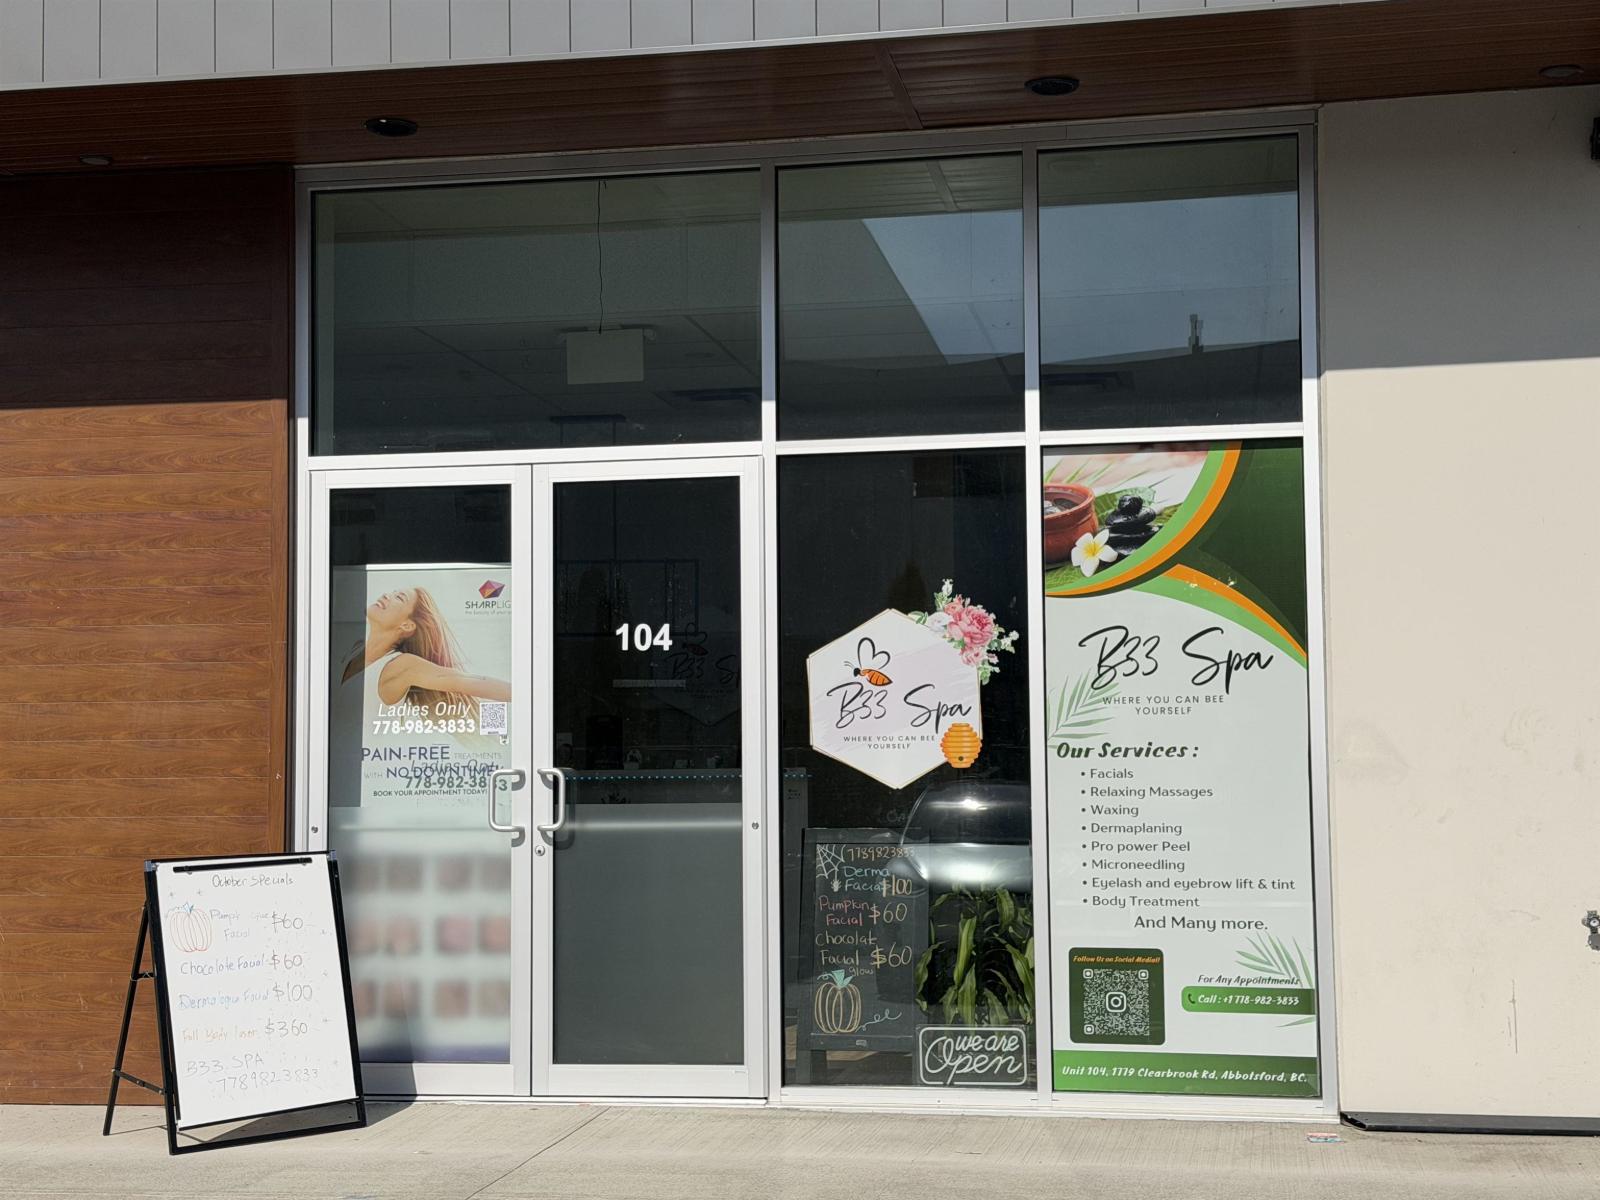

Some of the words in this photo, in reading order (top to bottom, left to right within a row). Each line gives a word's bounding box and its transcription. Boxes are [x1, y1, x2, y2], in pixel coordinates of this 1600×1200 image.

[615, 623, 673, 651] 104
[1078, 625, 1160, 691] B33
[1181, 626, 1274, 694] Spa
[826, 681, 888, 729] B33
[903, 683, 972, 734] Spa
[1102, 696, 1141, 705] WHERE
[1146, 696, 1170, 704] YOU
[1175, 695, 1200, 704] CAN
[1204, 695, 1224, 703] BEE
[378, 702, 429, 717] Ladies
[435, 701, 471, 718] Only
[1135, 706, 1192, 715] YOURSELF
[372, 719, 476, 735] 778-982-3833
[361, 746, 451, 762] PAIN-FREE
[1056, 742, 1094, 758] Our
[386, 767, 409, 779] NO
[1090, 768, 1134, 779] Facials
[405, 776, 508, 792] 778-982-383
[414, 789, 461, 797] APPOINTMENT
[1090, 786, 1146, 799] Relaxing
[1149, 786, 1214, 799] Massages
[1091, 805, 1139, 817] Waxing
[1091, 822, 1183, 836] Dermaplaning
[1091, 841, 1114, 852] Pro
[1117, 843, 1159, 854] power
[1162, 841, 1191, 852] Peel
[842, 866, 890, 878] Derma
[1092, 859, 1185, 872] Microneedling
[212, 874, 248, 888] October
[1092, 877, 1142, 891] Eyelash
[1145, 877, 1170, 889] and
[1174, 878, 1233, 891] eyebrow
[1236, 878, 1254, 890] lift
[1258, 879, 1269, 890] &
[1271, 878, 1296, 890] tint
[818, 894, 870, 913] Pumpkin
[1092, 895, 1126, 909] Body
[1129, 896, 1200, 908] Treatment
[826, 912, 864, 927] Facial
[868, 902, 908, 925] $60
[272, 911, 304, 933] $60
[1134, 915, 1166, 929] And
[1171, 916, 1217, 932] Many
[1221, 919, 1269, 931] more.
[820, 949, 860, 966] Facial
[869, 943, 913, 969] $60
[1073, 955, 1096, 963] Follow
[1114, 955, 1134, 963] Social
[180, 959, 236, 977] Chocolate
[238, 953, 265, 970] Facial
[1198, 975, 1214, 985] For
[1215, 975, 1233, 986] Any
[1233, 975, 1300, 987] Appointments
[272, 982, 313, 1002] $100
[1234, 996, 1300, 1006] 778-982-3833
[264, 1017, 308, 1041] $360
[955, 1036, 981, 1051] we
[984, 1034, 1020, 1051] are
[187, 1059, 224, 1077] B33
[232, 1053, 265, 1069] SPA
[925, 1036, 1022, 1085] Open
[1062, 1066, 1086, 1077] Unit
[1087, 1066, 1109, 1078] 104,
[1112, 1067, 1135, 1077] 1779
[1137, 1068, 1199, 1079] Clearbrook
[1201, 1069, 1218, 1081] Rd,
[1220, 1070, 1287, 1083] Abbotsford,
[1289, 1073, 1308, 1083] BC.
